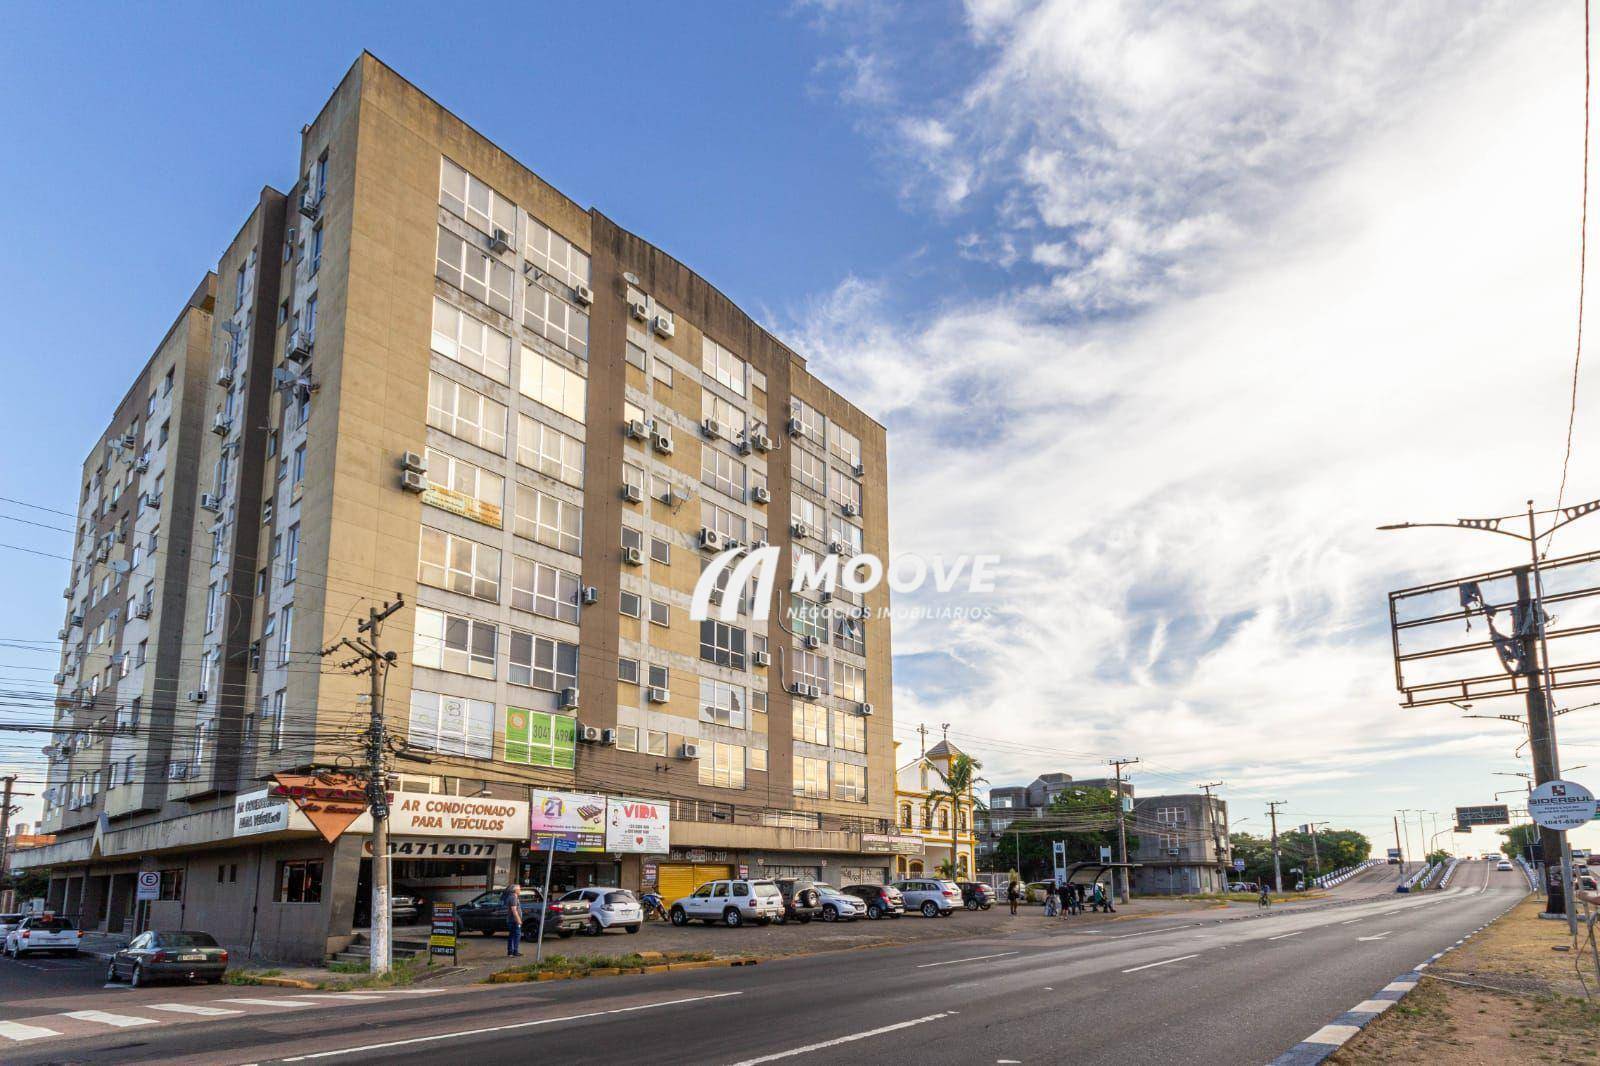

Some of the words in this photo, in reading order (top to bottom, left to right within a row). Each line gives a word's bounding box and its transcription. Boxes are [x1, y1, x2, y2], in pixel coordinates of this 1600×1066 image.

[401, 800, 421, 812] AR
[426, 801, 516, 818] CONDICIONADO
[544, 799, 563, 817] 21
[1528, 796, 1591, 806] SIDERSUL
[623, 804, 658, 820] VIDA
[411, 815, 443, 829] PARA
[450, 816, 505, 832] VEÍCULOS
[146, 875, 154, 884] E
